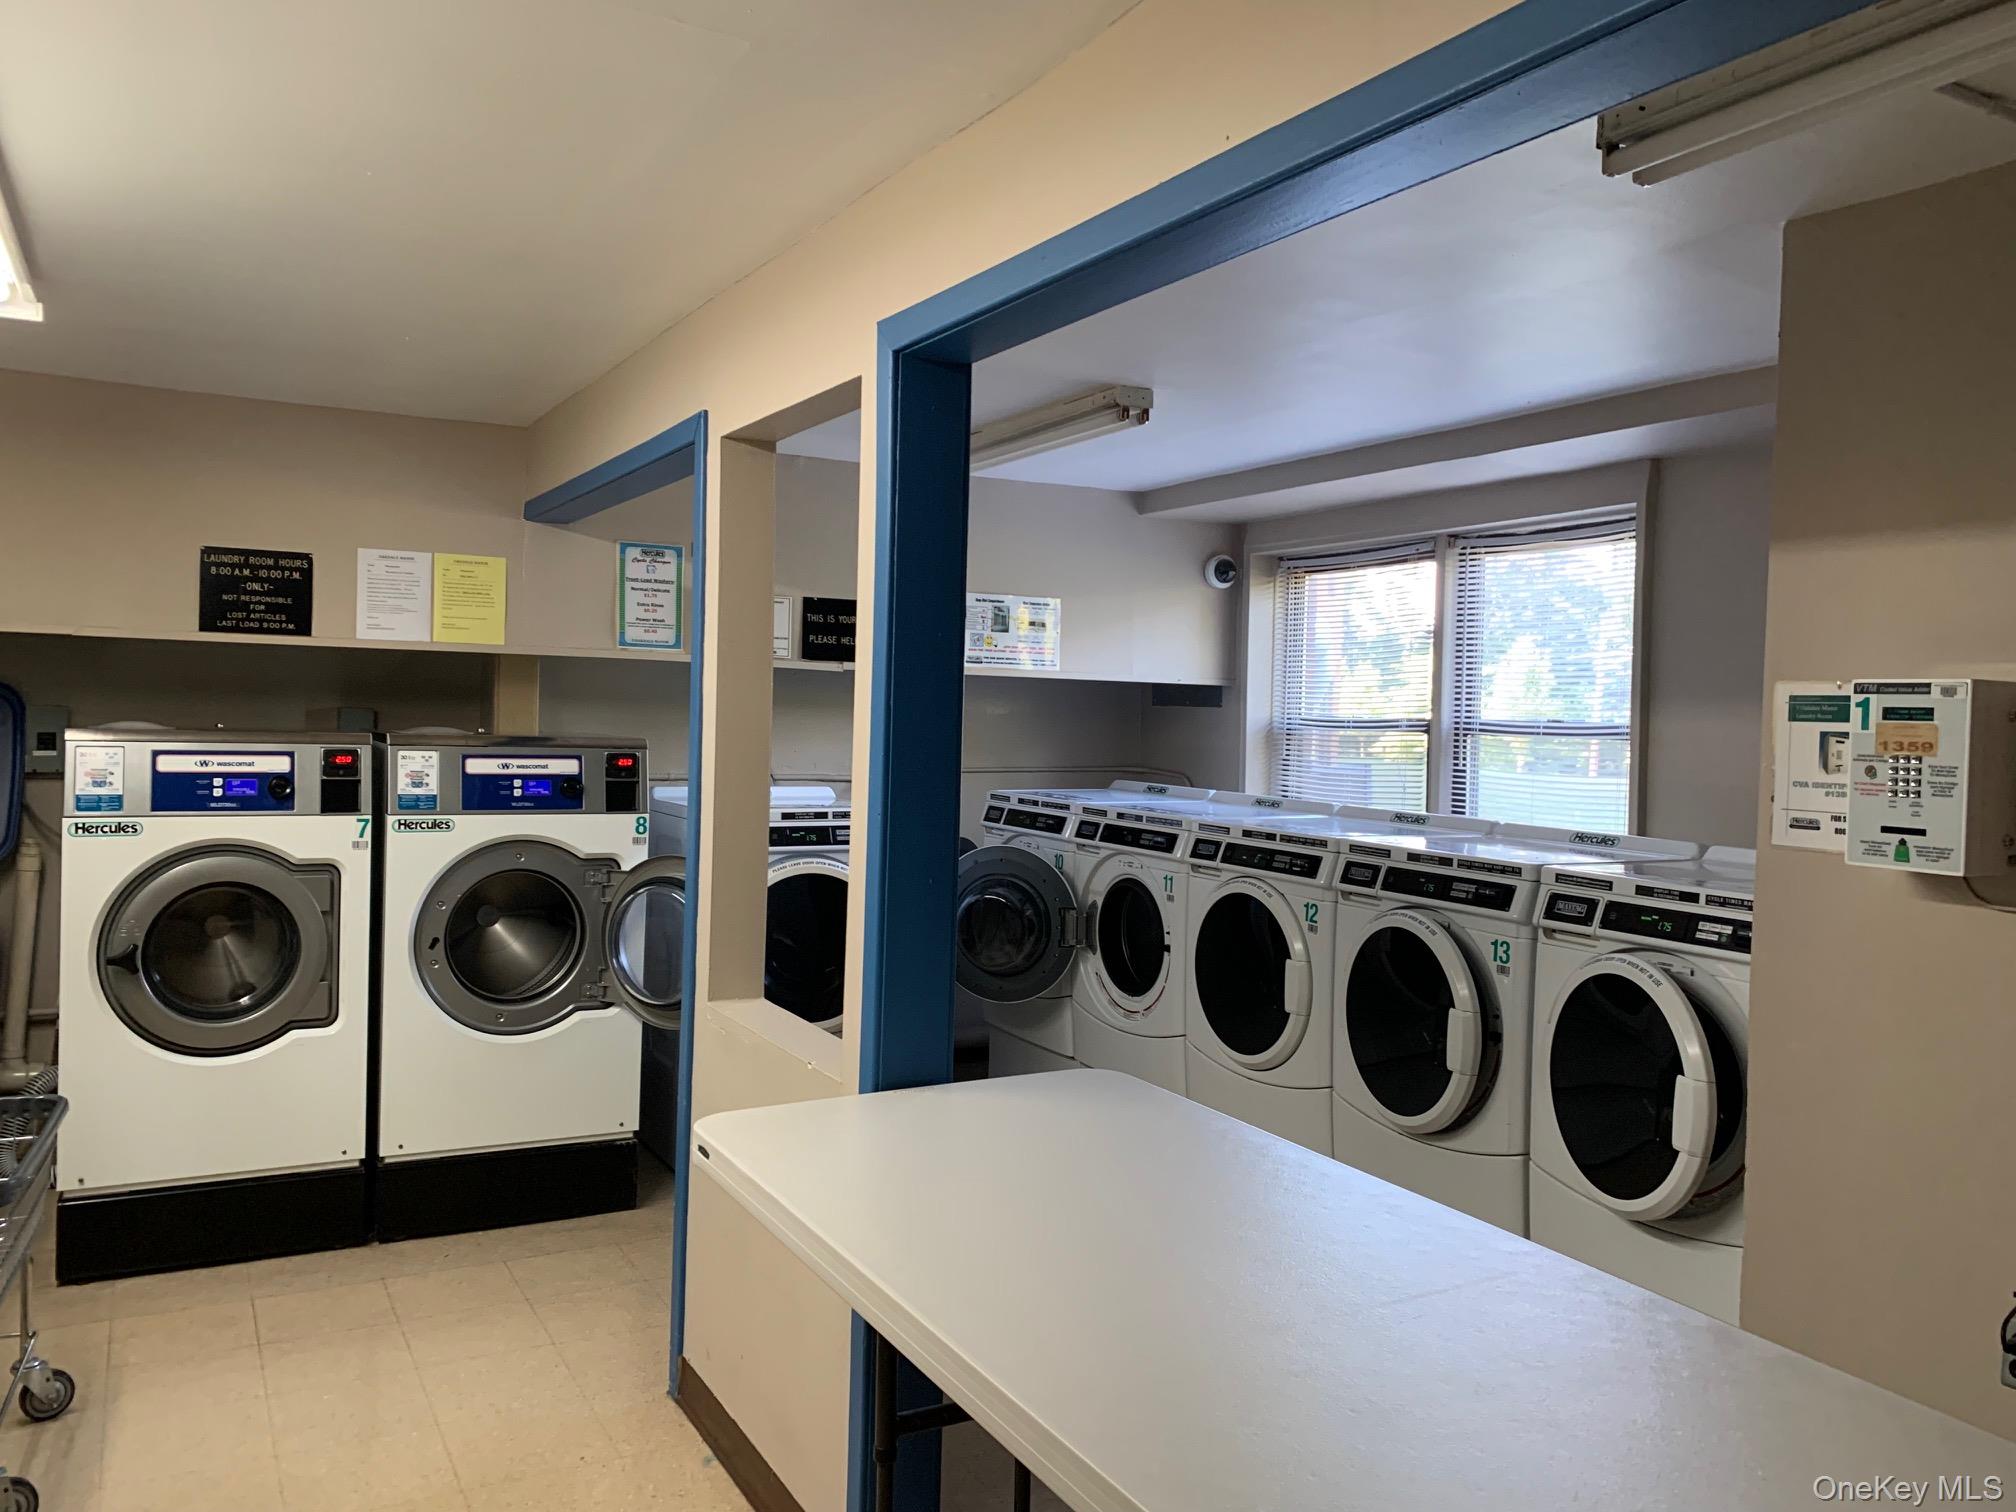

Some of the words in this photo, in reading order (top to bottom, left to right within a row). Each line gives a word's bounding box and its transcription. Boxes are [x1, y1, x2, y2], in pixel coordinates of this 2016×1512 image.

[204, 554, 245, 565] LAUNDRY
[249, 556, 274, 566] ROOM
[278, 558, 309, 568] HOURS
[210, 566, 231, 575] 8:00
[284, 570, 303, 579] P.M.
[240, 595, 293, 604] RESPONSIBLE
[249, 613, 287, 621] ARTICLES
[807, 613, 824, 622] THIS
[827, 615, 836, 623] IS
[809, 635, 837, 645] PLEASE
[840, 636, 855, 645] HEL
[1856, 684, 1878, 693] VTM
[1855, 697, 1870, 730] 1
[1878, 740, 1934, 753] 1359
[397, 819, 452, 831] Hercules
[1392, 813, 1428, 824] Hercules
[75, 822, 138, 834] Hercules
[356, 818, 370, 838] 7
[635, 816, 648, 835] 8
[1573, 833, 1618, 846] Hercules
[1054, 852, 1064, 870] 10
[1163, 874, 1174, 894] 11
[1303, 901, 1319, 924] 12
[1490, 938, 1511, 965] 13
[1626, 960, 1639, 970] WHEN
[1652, 977, 1664, 987] USE
